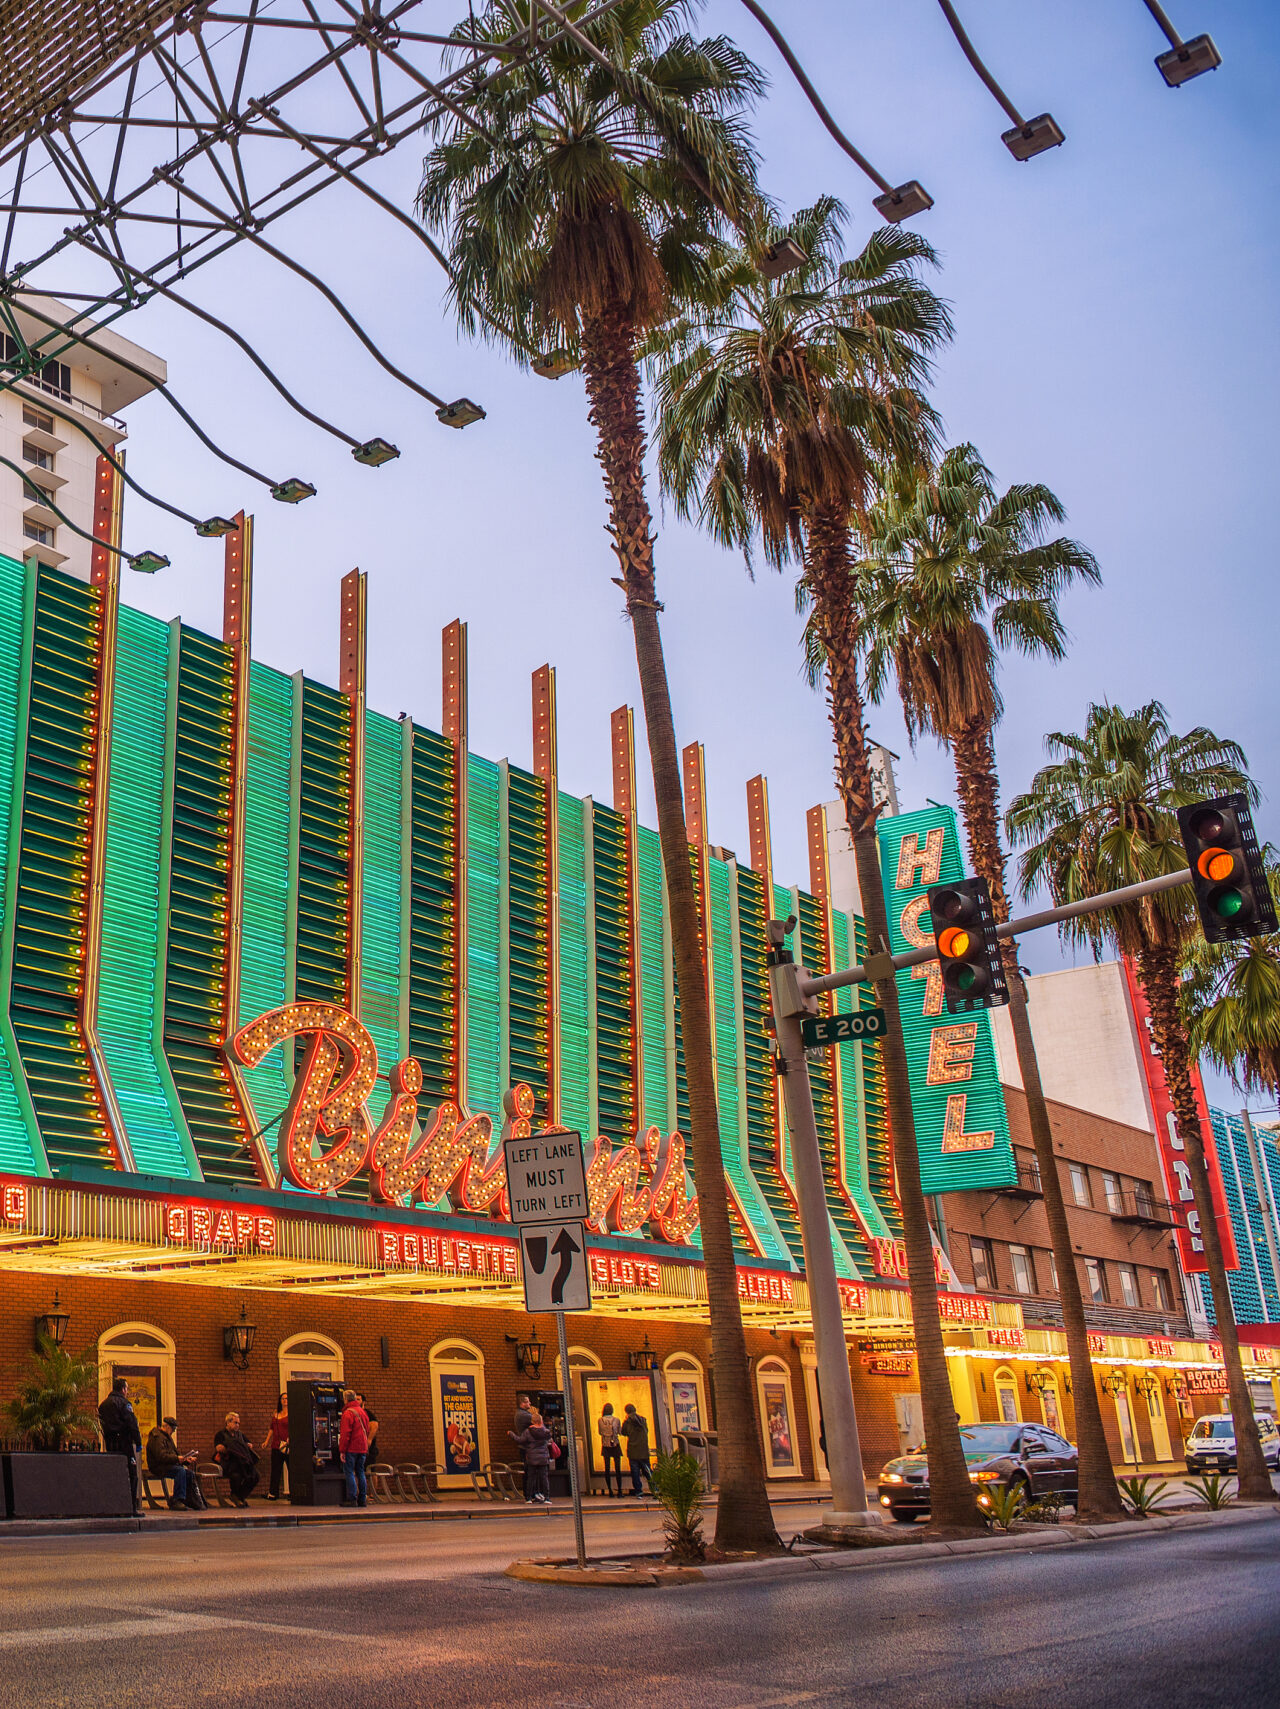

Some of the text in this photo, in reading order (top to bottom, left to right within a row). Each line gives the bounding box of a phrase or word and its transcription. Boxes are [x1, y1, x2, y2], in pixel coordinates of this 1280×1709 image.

[815, 1015, 880, 1040] E 200
[226, 1002, 701, 1243] Binin's
[512, 1144, 575, 1163] LEFT LANE
[526, 1168, 565, 1188] MUST
[516, 1193, 581, 1212] TURN LEFT
[167, 1204, 275, 1250] CRAPS
[383, 1232, 518, 1276] ROULETTE
[875, 1237, 951, 1284] HOL
[596, 1257, 660, 1290] SLOTS
[737, 1273, 793, 1300] ALOON
[937, 1296, 992, 1320] TAURANT
[990, 1329, 1024, 1347] POKER
[1151, 1341, 1176, 1356] SLOTS
[1186, 1370, 1228, 1380] BOTTLE
[1192, 1379, 1228, 1389] LIQUO
[444, 1402, 474, 1411] THE GAMES
[445, 1411, 475, 1428] HERE!
